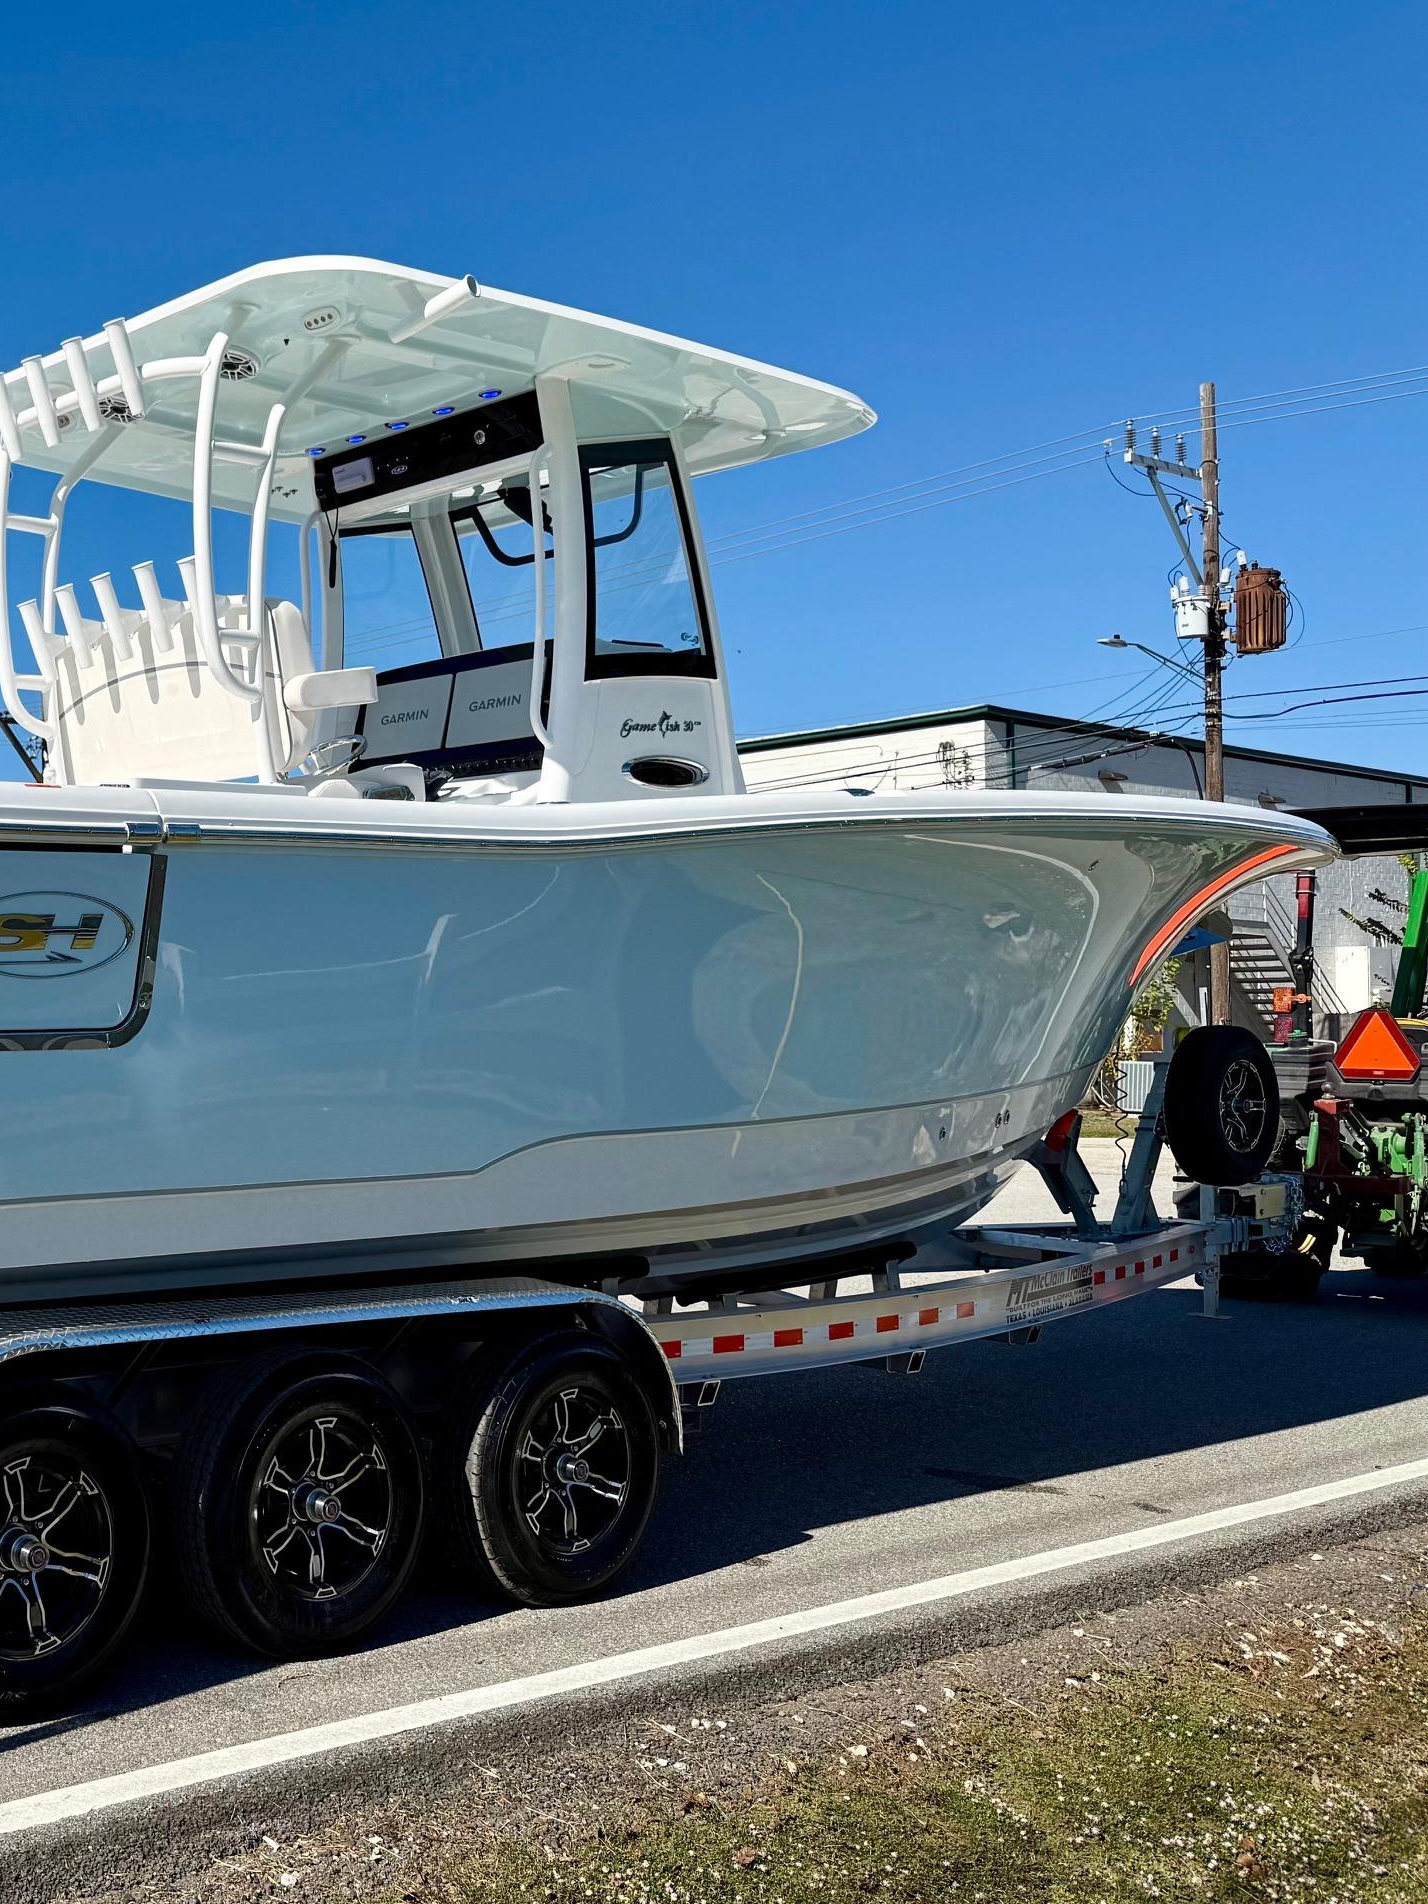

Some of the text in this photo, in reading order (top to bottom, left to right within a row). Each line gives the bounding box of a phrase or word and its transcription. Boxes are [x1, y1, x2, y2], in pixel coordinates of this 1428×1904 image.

[469, 694, 522, 712] GARMIN
[381, 708, 430, 726] GARMIN
[1031, 1263, 1093, 1292] McClain Trailers
[1027, 1299, 1040, 1309] FOR
[1041, 1296, 1052, 1305] THE
[1052, 1291, 1073, 1303] LONG
[1006, 1311, 1026, 1324] TEXAS
[1032, 1302, 1064, 1317] LOUISIANA
